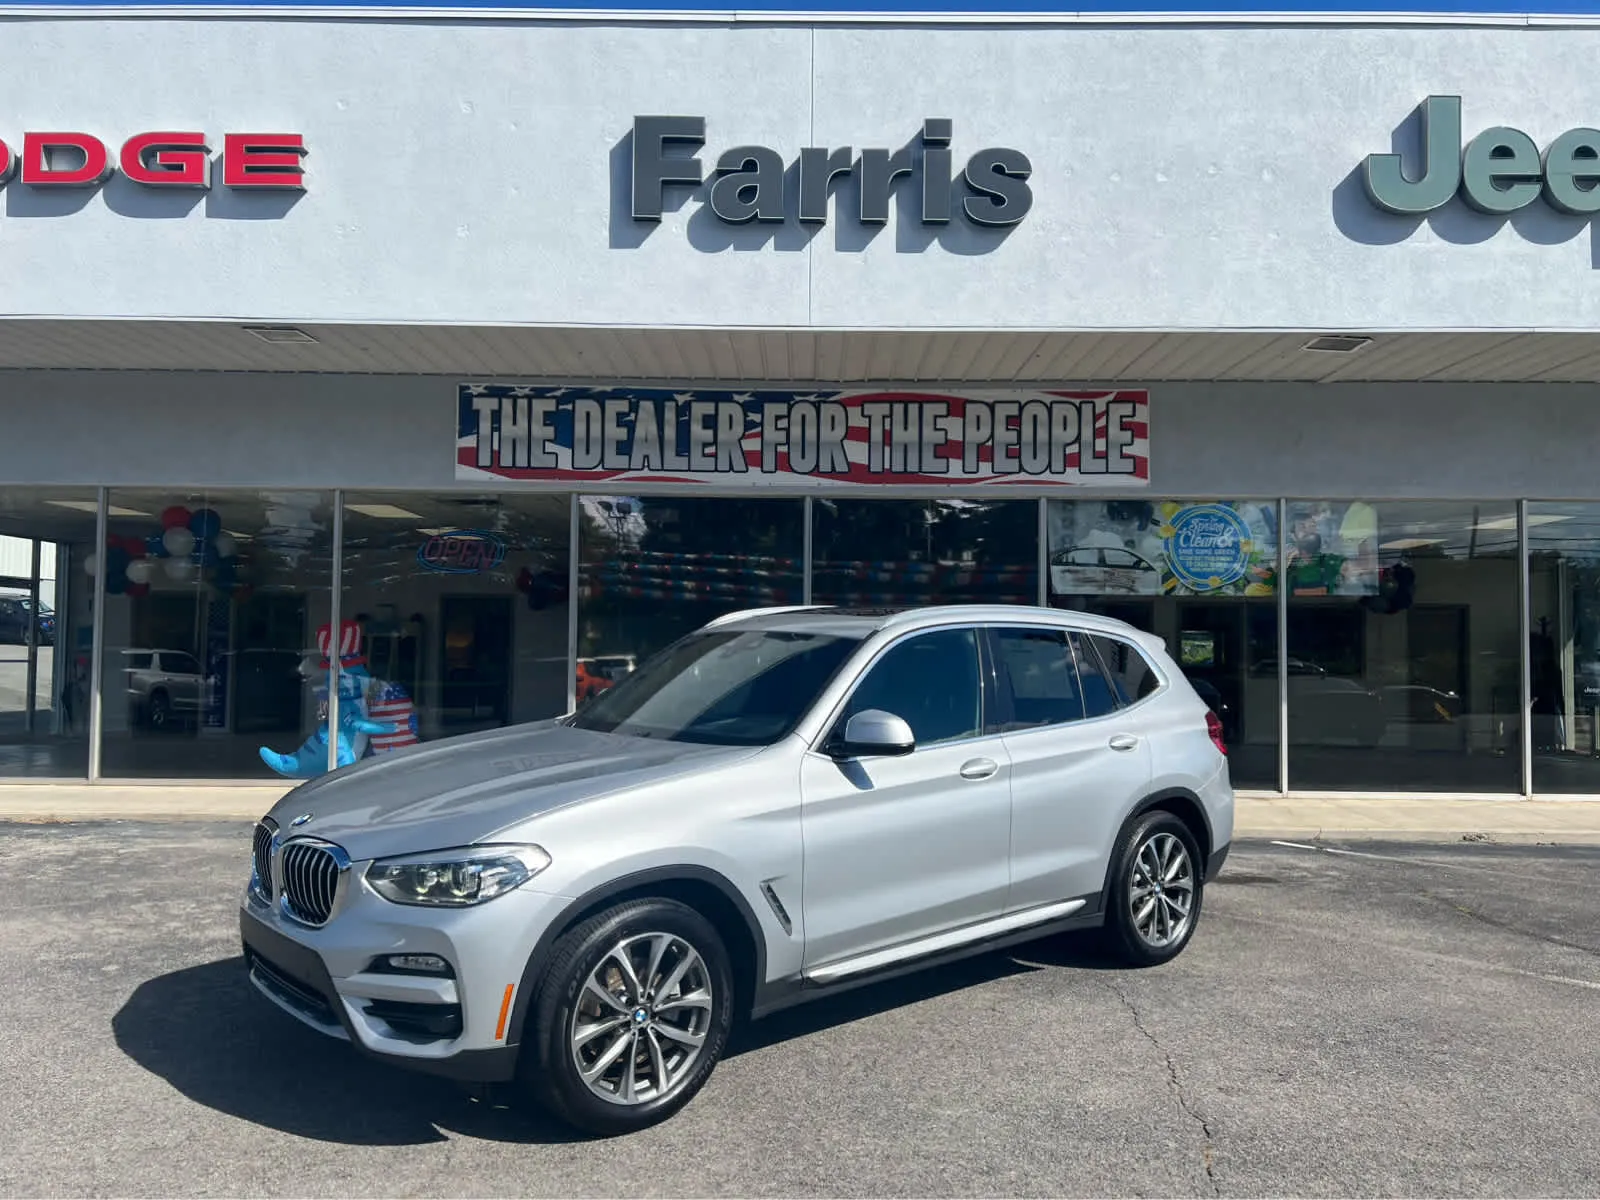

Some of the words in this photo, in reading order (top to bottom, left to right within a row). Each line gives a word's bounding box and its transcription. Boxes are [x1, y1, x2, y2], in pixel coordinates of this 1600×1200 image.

[0, 131, 305, 189] DGE
[632, 115, 1034, 225] Farris
[472, 397, 558, 469] THE
[571, 398, 749, 474] DEALER
[761, 400, 849, 475] FOR
[861, 401, 950, 474] THE
[962, 400, 1137, 475] PEOPLE
[424, 535, 496, 569] OPEN
